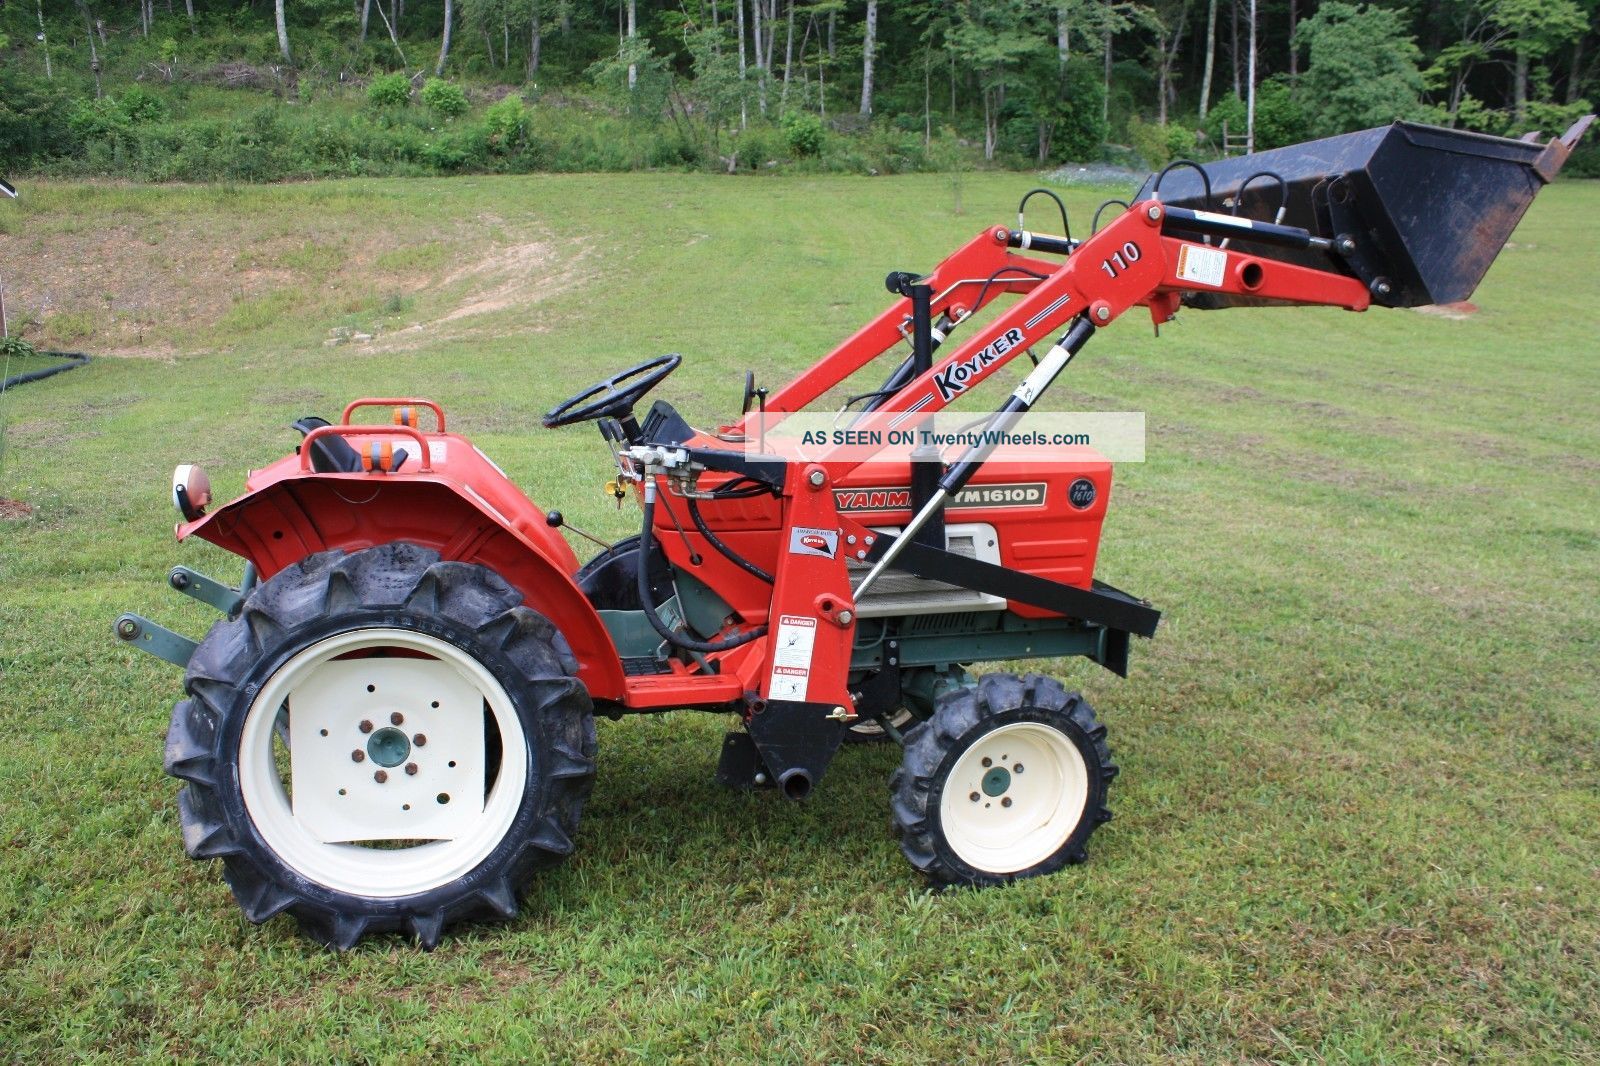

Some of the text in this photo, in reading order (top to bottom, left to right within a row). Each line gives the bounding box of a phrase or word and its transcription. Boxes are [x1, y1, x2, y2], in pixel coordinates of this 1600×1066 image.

[1101, 241, 1141, 278] 110
[933, 328, 1024, 401] KOYKER
[836, 491, 911, 508] YANM
[790, 619, 814, 627] DANGER
[783, 668, 807, 676] DANGER
